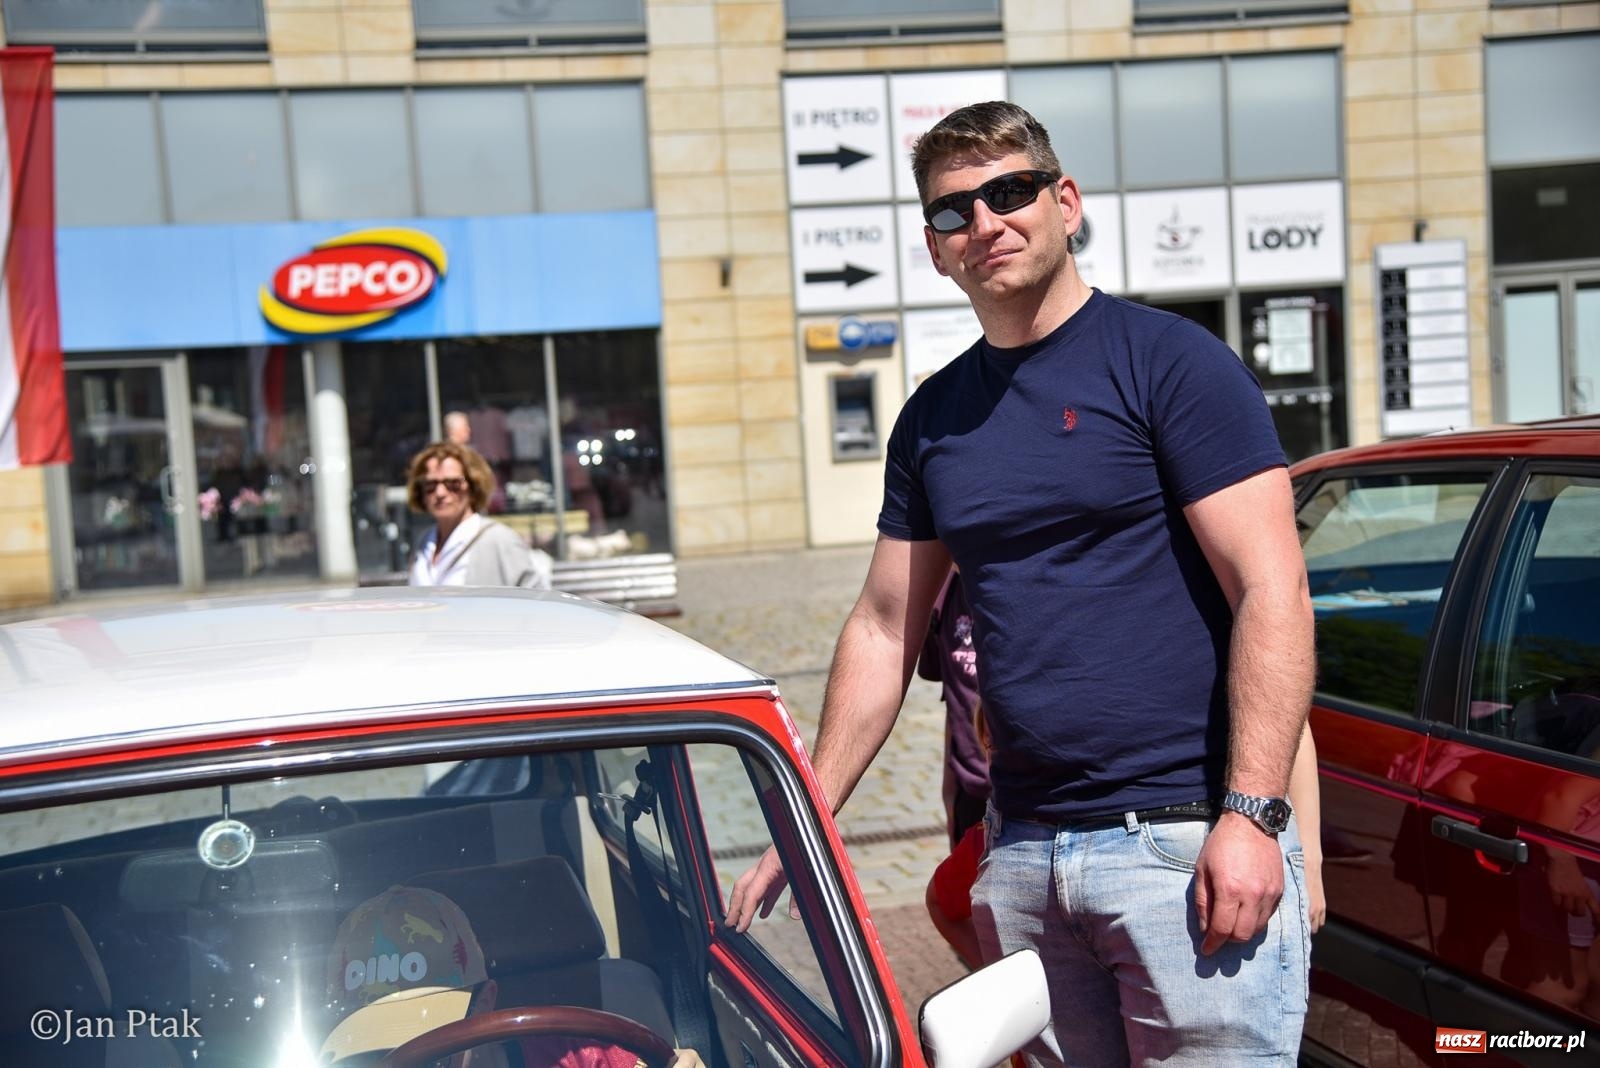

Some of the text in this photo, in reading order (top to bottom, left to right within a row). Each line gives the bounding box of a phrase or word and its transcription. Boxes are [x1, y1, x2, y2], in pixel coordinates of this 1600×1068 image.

[810, 107, 879, 128] PIĘTRO
[814, 226, 882, 247] PIĘTRO
[1248, 224, 1323, 252] LODY
[287, 259, 421, 299] PEPCO
[344, 950, 428, 992] DINO
